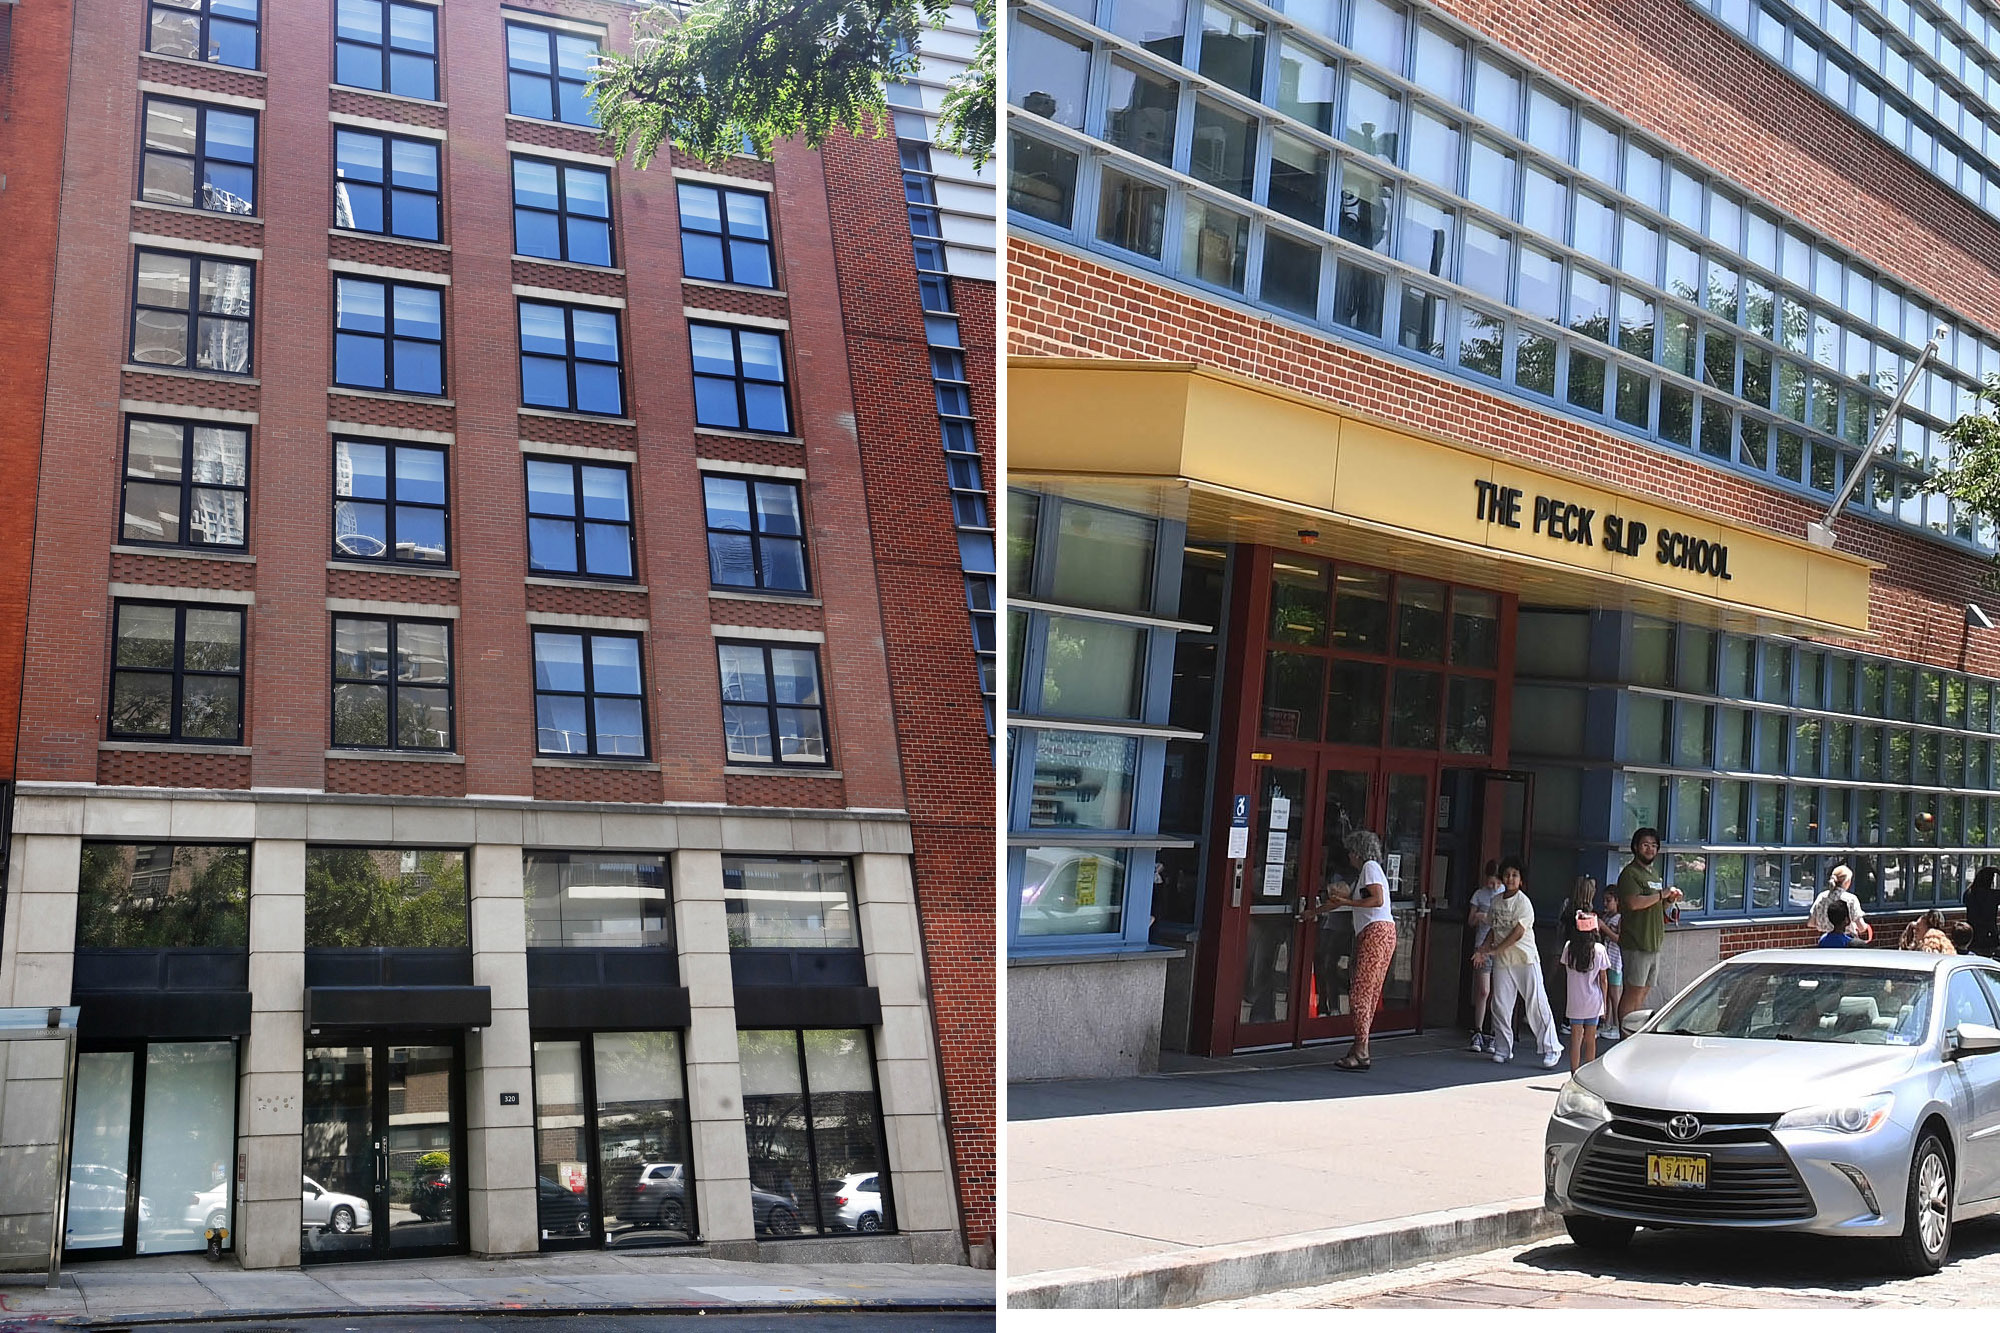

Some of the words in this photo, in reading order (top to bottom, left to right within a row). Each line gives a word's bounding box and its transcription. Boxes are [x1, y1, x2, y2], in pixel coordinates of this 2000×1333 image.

[1475, 479, 1522, 529] THE
[1533, 496, 1595, 546] PECK
[1603, 514, 1647, 557] SLIP
[1656, 529, 1732, 580] SCHOOL
[504, 1095, 516, 1103] 320
